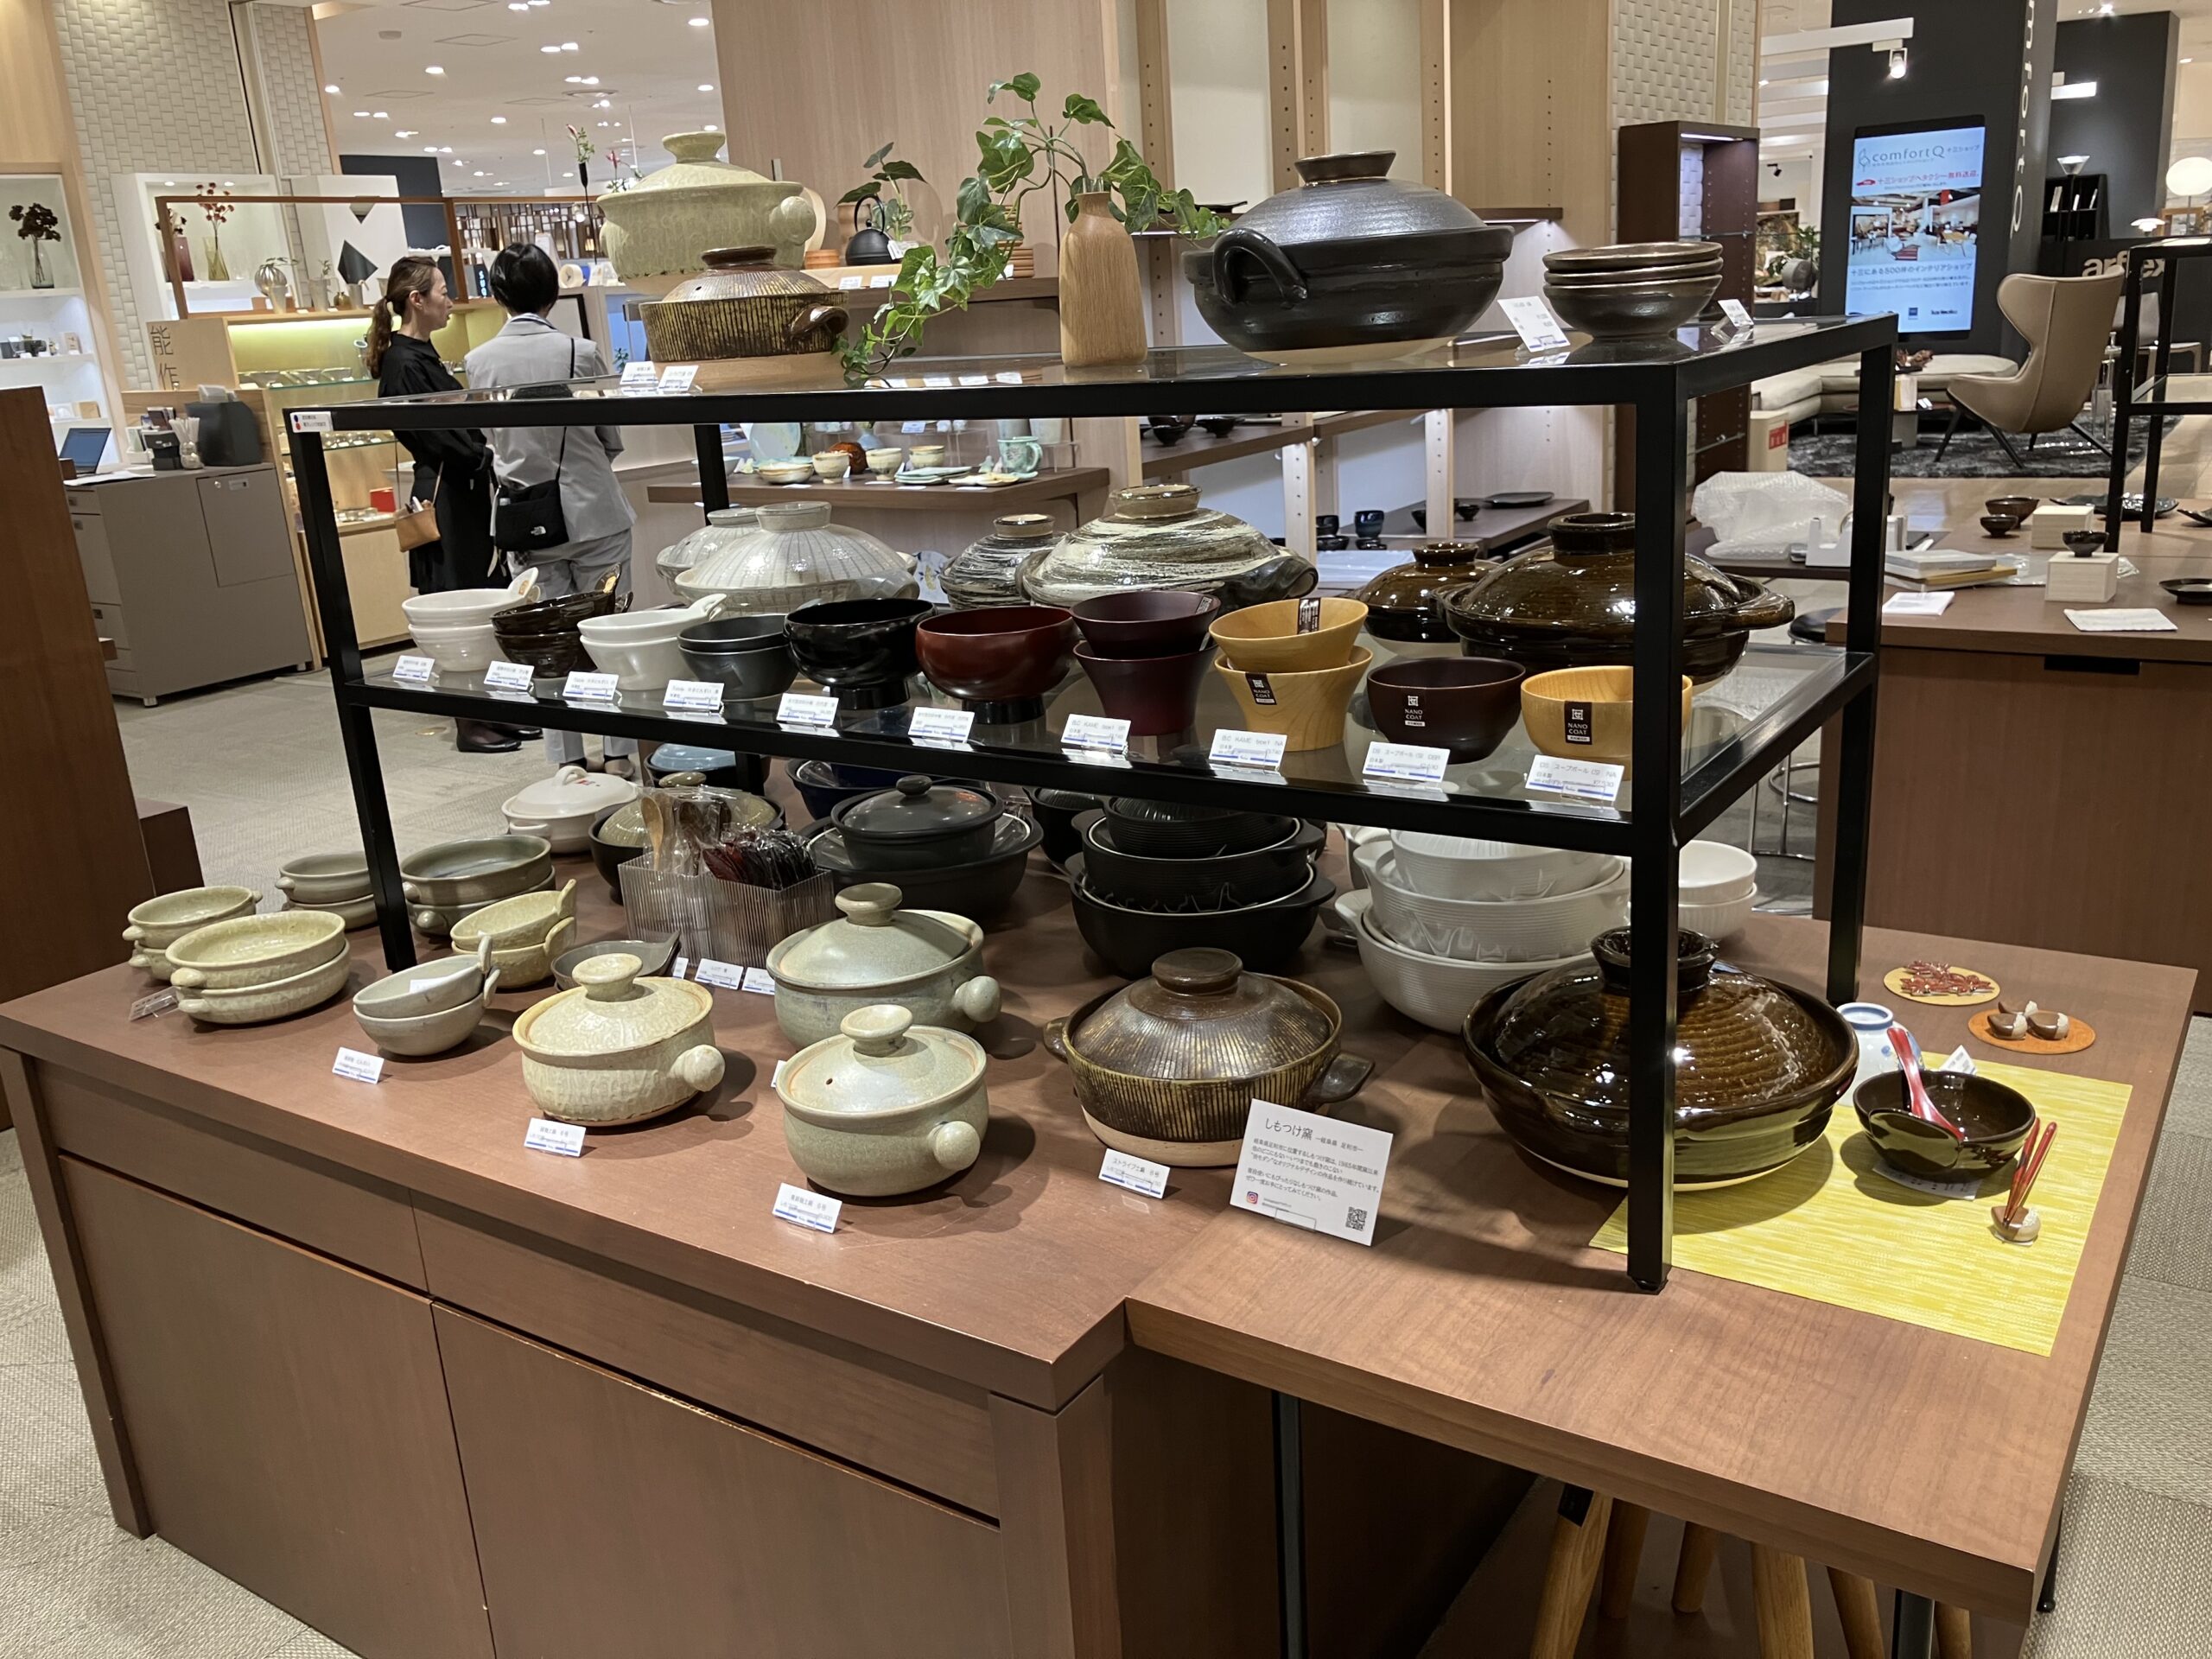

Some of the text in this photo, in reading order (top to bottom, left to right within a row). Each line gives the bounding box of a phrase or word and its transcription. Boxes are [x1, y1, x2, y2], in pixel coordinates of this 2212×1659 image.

[2082, 250, 2165, 277] arfex
[150, 326, 179, 390] 能作
[1265, 1118, 1313, 1141] しもつけ窯
